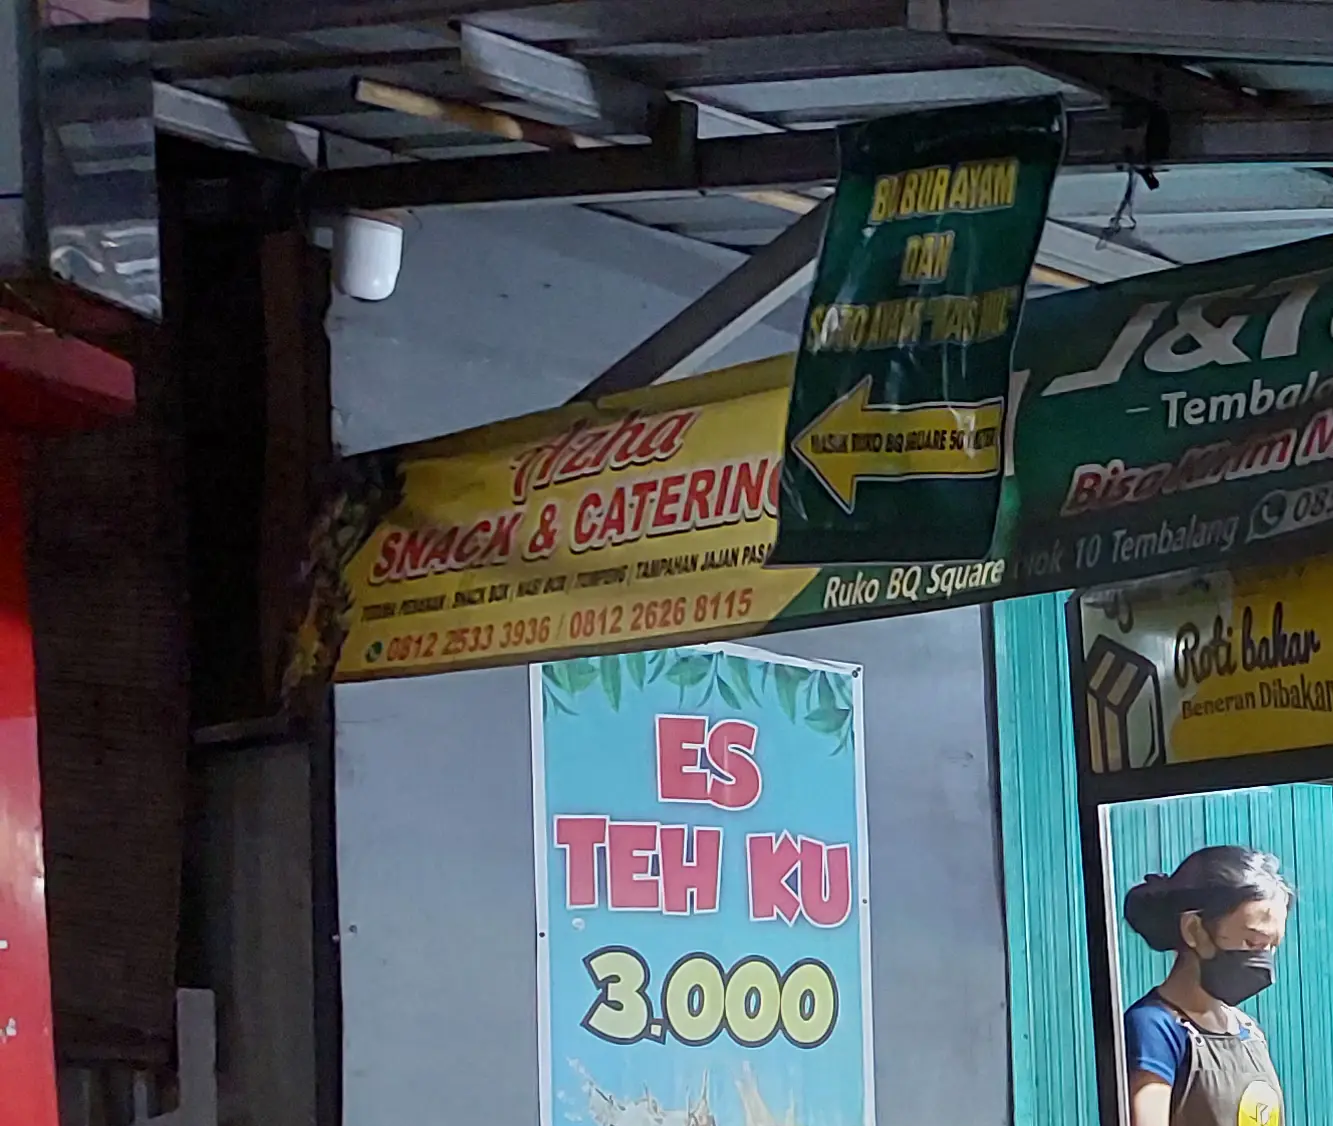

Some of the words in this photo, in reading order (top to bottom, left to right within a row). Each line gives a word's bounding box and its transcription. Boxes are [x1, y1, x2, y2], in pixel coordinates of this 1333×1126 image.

[869, 165, 953, 225] BUBUR
[948, 158, 1020, 213] AYAM
[900, 230, 956, 284] DAN
[511, 408, 701, 502] Azha
[1062, 458, 1168, 516] Bisa
[368, 511, 524, 587] SNACK
[523, 503, 560, 561] &
[700, 549, 739, 573] JAJAN
[823, 573, 882, 610] Ruko
[886, 565, 922, 604] BQ
[924, 554, 1007, 602] Square
[1074, 533, 1102, 569] 10
[1111, 513, 1240, 564] Tembalang
[386, 631, 435, 663] 0812
[441, 623, 494, 656] 2533
[500, 616, 551, 648] 3936
[569, 607, 623, 640] 0812
[630, 597, 687, 630] 2626
[693, 587, 755, 619] 8115
[1174, 611, 1237, 689] Roti
[1233, 600, 1321, 675] bakar
[1180, 689, 1257, 722] Beneran
[654, 713, 762, 811] ES
[552, 813, 723, 916] TEH
[745, 830, 856, 929] KU
[580, 944, 840, 1048] 3.000
